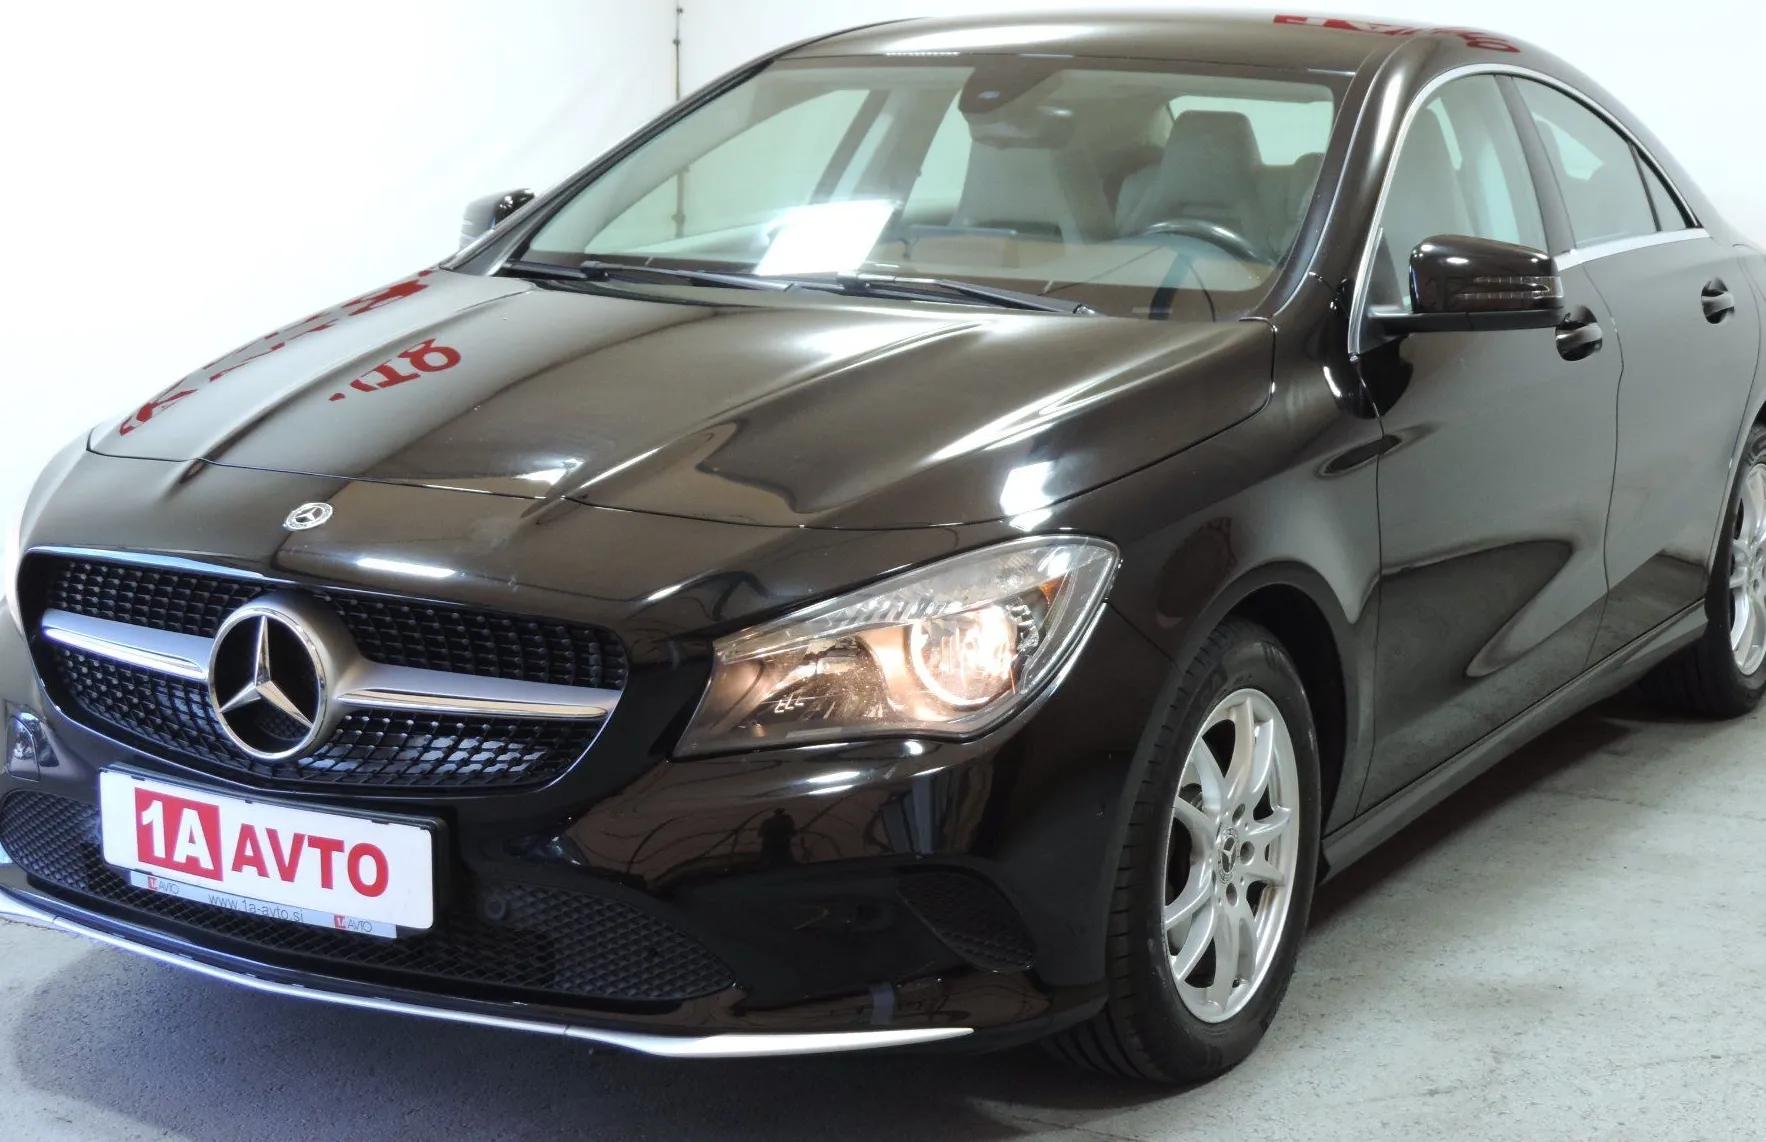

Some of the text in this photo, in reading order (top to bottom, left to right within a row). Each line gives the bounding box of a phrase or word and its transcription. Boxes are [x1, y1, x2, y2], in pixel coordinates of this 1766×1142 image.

[140, 797, 390, 898] 1A AVTO
[208, 894, 304, 922] www.1a-avto.si
